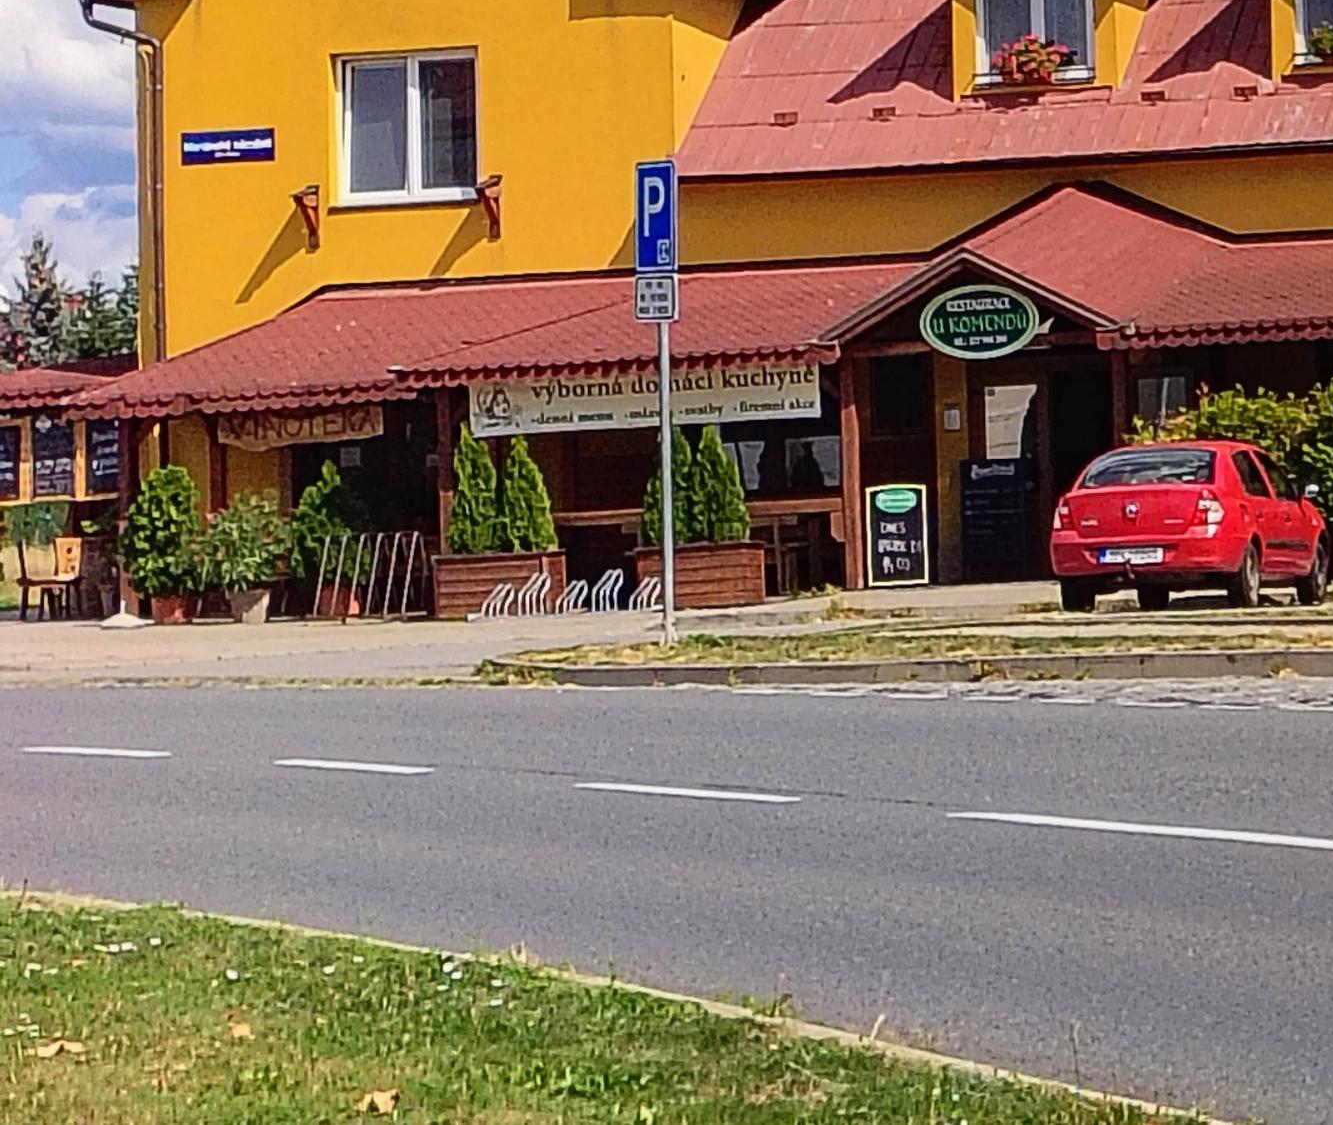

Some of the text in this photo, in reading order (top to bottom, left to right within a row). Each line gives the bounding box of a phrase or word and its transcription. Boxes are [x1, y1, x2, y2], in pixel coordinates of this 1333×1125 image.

[643, 176, 666, 238] P
[932, 309, 1027, 335] U KOMENDŮ
[531, 375, 623, 405] výborná
[721, 365, 814, 392] kuchyně
